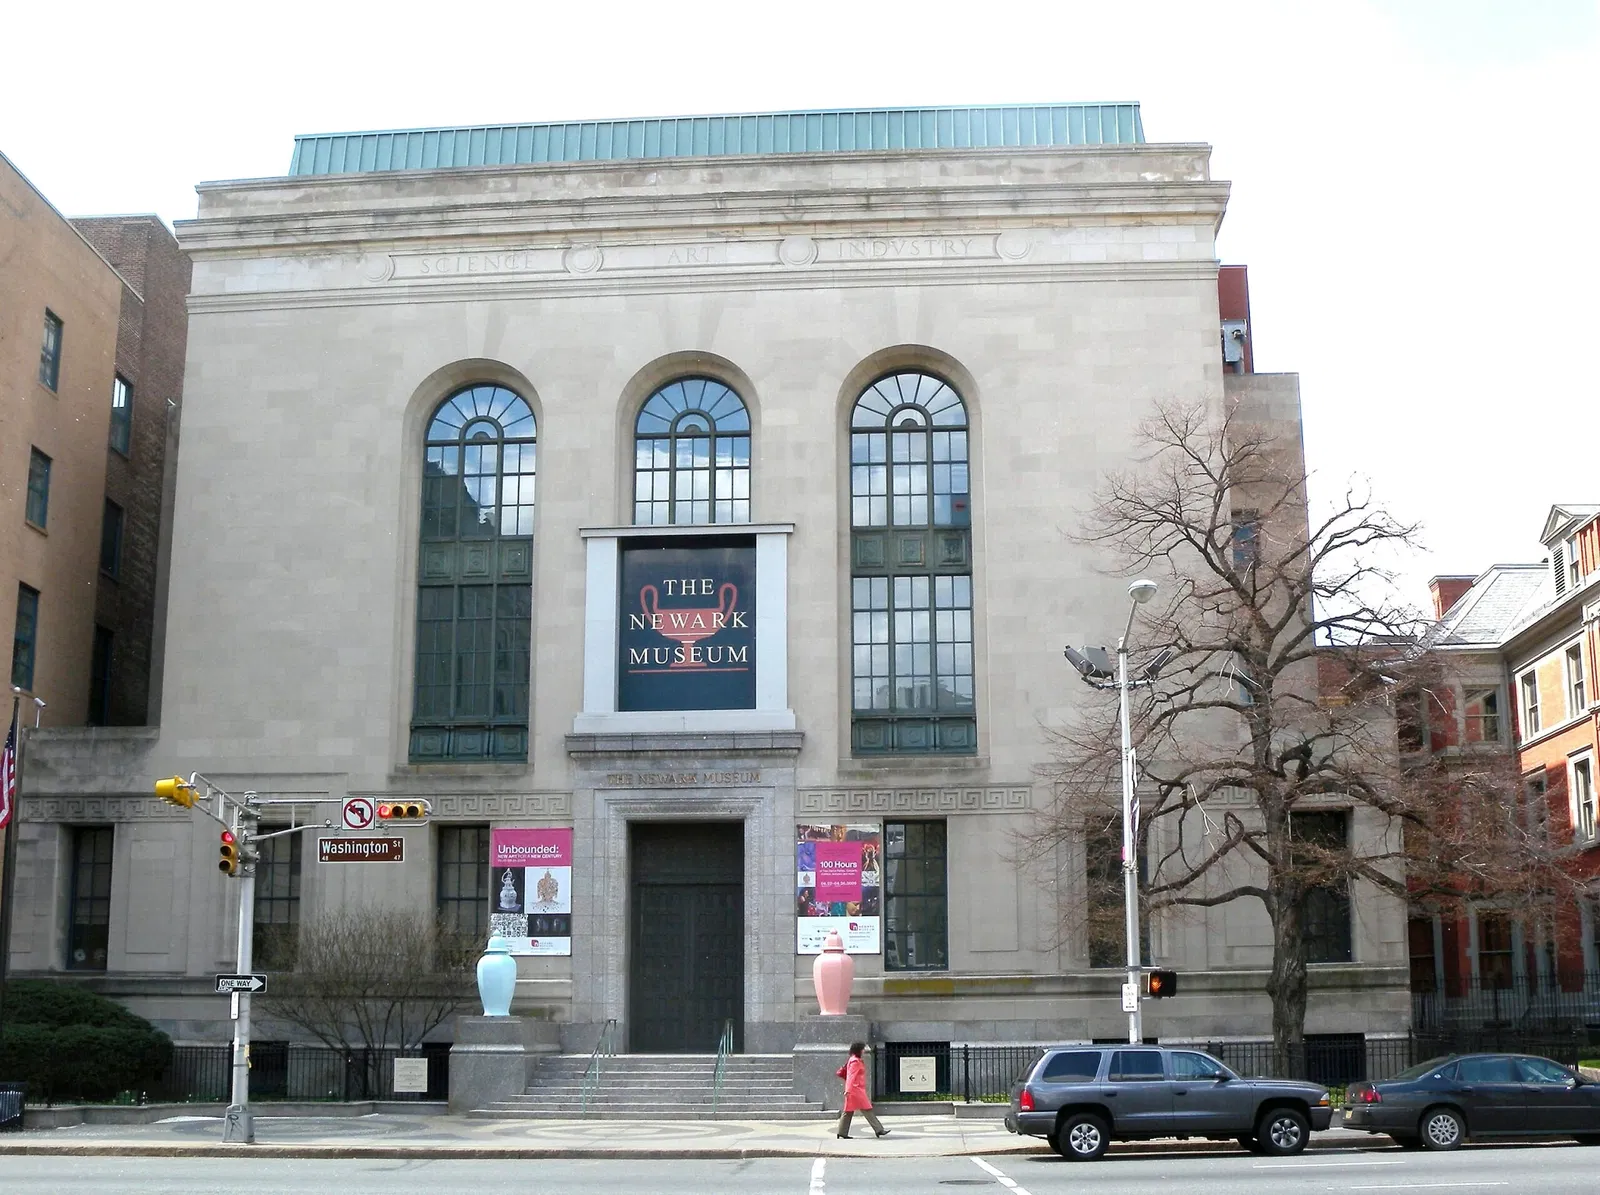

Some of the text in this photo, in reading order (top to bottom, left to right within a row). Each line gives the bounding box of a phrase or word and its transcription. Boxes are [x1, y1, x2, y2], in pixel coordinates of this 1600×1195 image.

[668, 246, 716, 264] ART
[838, 239, 973, 257] INDVSTRY
[420, 254, 533, 274] SCIENCE
[663, 578, 715, 596] THE
[629, 611, 749, 630] NEWARK
[629, 645, 748, 665] MUSEUM
[606, 771, 762, 786] THE NEWARK MUSEUM
[321, 840, 401, 858] Washington St
[498, 844, 560, 854] Unbounded:
